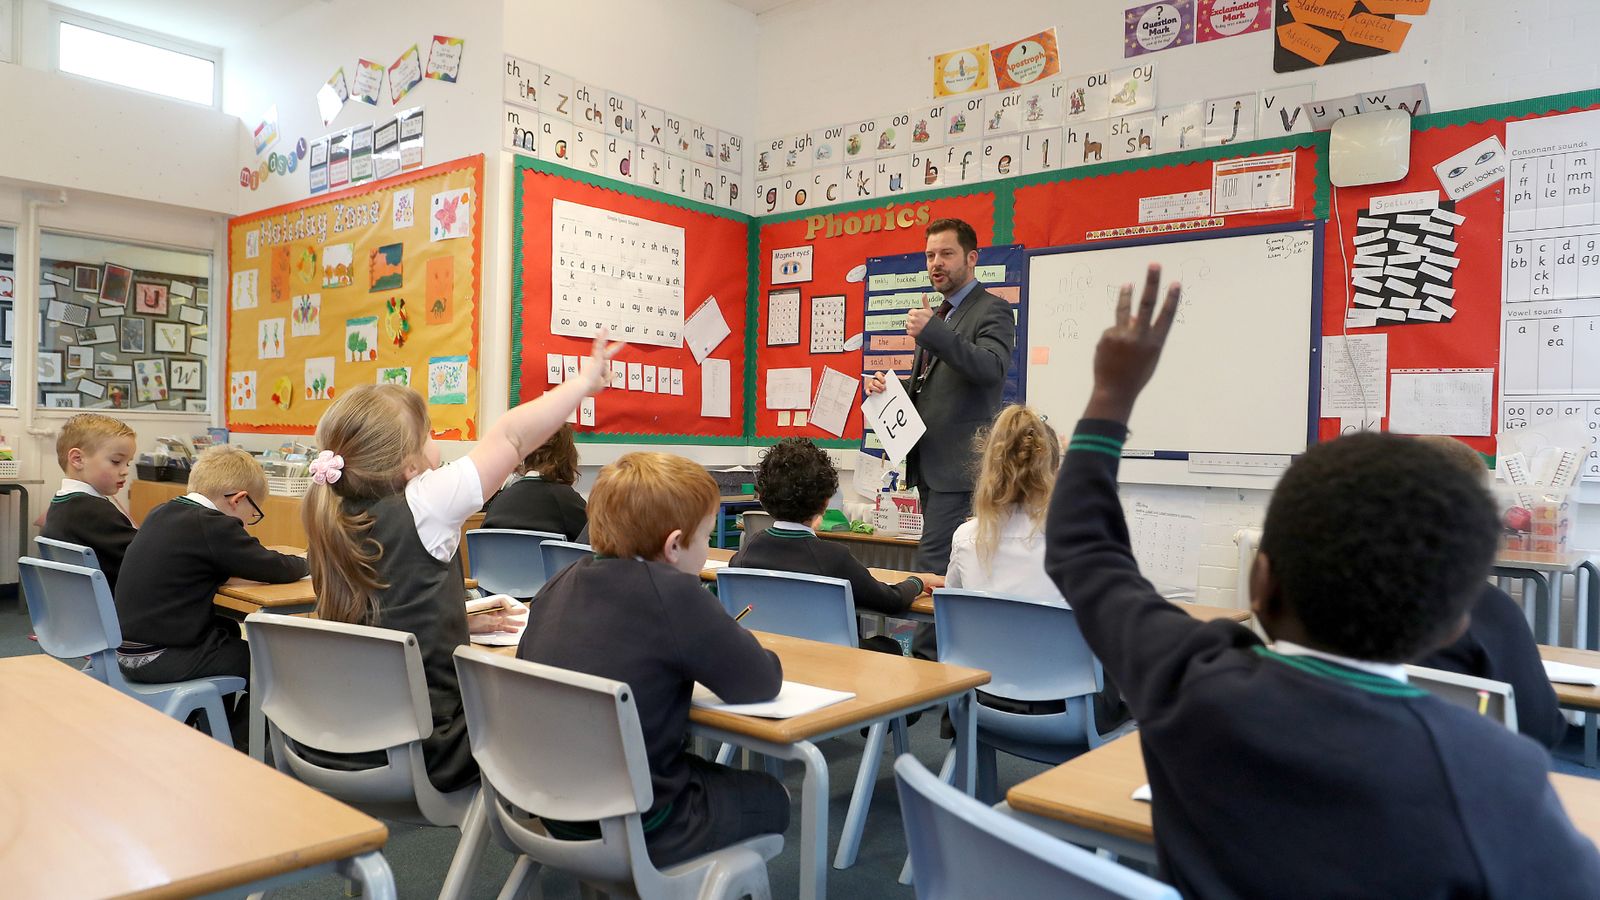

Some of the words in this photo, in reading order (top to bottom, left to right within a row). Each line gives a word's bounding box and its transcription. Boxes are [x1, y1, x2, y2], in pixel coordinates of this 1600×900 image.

[1210, 1, 1260, 16] Exclamation
[1222, 11, 1246, 22] Mark
[1294, 0, 1346, 21] Statements
[1142, 17, 1177, 30] Question
[1149, 26, 1170, 36] Mark
[1354, 17, 1393, 32] Capital
[1286, 28, 1322, 54] Adjectives
[1132, 64, 1153, 82] oy
[507, 61, 520, 78] th
[543, 74, 551, 86] z
[576, 86, 589, 103] ch
[608, 97, 624, 112] qu
[640, 109, 648, 121] x
[666, 118, 681, 134] ng
[693, 127, 705, 142] nk
[729, 136, 742, 151] ay
[771, 140, 784, 152] ee
[794, 134, 813, 152] igh
[824, 128, 843, 140] ow
[859, 122, 876, 134] oo
[892, 115, 909, 127] oo
[930, 105, 945, 119] ar
[967, 98, 983, 111] or
[1002, 92, 1021, 107] air
[1051, 83, 1063, 98] ir
[1087, 73, 1108, 88] ou
[1313, 105, 1326, 118] y
[1367, 94, 1387, 106] w
[507, 111, 519, 125] m
[543, 122, 552, 134] a
[577, 131, 584, 143] s
[609, 139, 617, 153] d
[694, 167, 702, 179] n
[720, 175, 728, 189] p
[756, 185, 763, 198] g
[785, 180, 793, 190] o
[815, 175, 821, 185] c
[845, 166, 853, 180] k
[878, 162, 886, 174] u
[912, 153, 920, 168] b
[948, 147, 955, 163] f
[984, 144, 993, 156] e
[1067, 128, 1078, 143] h
[1112, 118, 1131, 135] sh
[1161, 114, 1169, 126] r
[1207, 103, 1216, 125] j
[1511, 145, 1556, 157] Consonant
[1557, 140, 1588, 152] sounds
[1574, 158, 1587, 167] m
[1454, 180, 1475, 194] eyes
[1475, 164, 1506, 183] looking
[1520, 177, 1528, 187] ff
[1567, 171, 1592, 181] mm
[1514, 190, 1532, 204] ph
[1544, 187, 1557, 198] le
[1569, 184, 1591, 196] mb
[260, 208, 329, 247] Holiday
[334, 199, 382, 234] Zone
[804, 201, 931, 241] Phonics
[651, 242, 659, 251] sh
[662, 244, 669, 253] th
[671, 248, 680, 258] ng
[775, 251, 795, 261] Magnet
[796, 249, 811, 259] eyes
[1515, 243, 1524, 254] b
[1539, 244, 1547, 253] c
[1563, 240, 1571, 251] d
[1587, 240, 1596, 252] g
[671, 257, 680, 267] nk
[1510, 257, 1528, 269] bb
[1539, 255, 1546, 266] k
[1557, 253, 1576, 264] dd
[1581, 255, 1600, 266] gg
[627, 270, 637, 281] qu
[673, 276, 681, 287] ch
[981, 270, 996, 278] Ann
[1534, 270, 1550, 281] ck
[1059, 274, 1094, 293] nice
[1533, 284, 1550, 296] ch
[144, 289, 160, 309] U
[871, 298, 893, 308] jumping
[632, 303, 641, 314] ay
[646, 304, 655, 313] ee
[657, 306, 668, 317] igh
[670, 308, 680, 317] ow
[1507, 309, 1531, 318] Vowel
[1533, 307, 1562, 316] sounds
[560, 318, 571, 327] oo
[579, 320, 588, 328] oo
[595, 322, 603, 330] ar
[611, 324, 619, 332] or
[625, 325, 636, 334] air
[669, 331, 678, 341] oy
[1518, 325, 1527, 335] a
[1552, 324, 1560, 333] e
[878, 338, 889, 346] the
[1547, 338, 1565, 347] ea
[871, 357, 884, 366] said
[174, 366, 198, 385] W
[550, 364, 561, 376] ay
[567, 365, 576, 374] ee
[631, 373, 641, 382] oo
[661, 375, 669, 384] or
[583, 406, 593, 418] oy
[1508, 407, 1526, 416] oo
[1536, 407, 1554, 416] oo
[1564, 407, 1581, 416] ar
[883, 408, 908, 439] i-e
[1505, 420, 1528, 430] u-e
